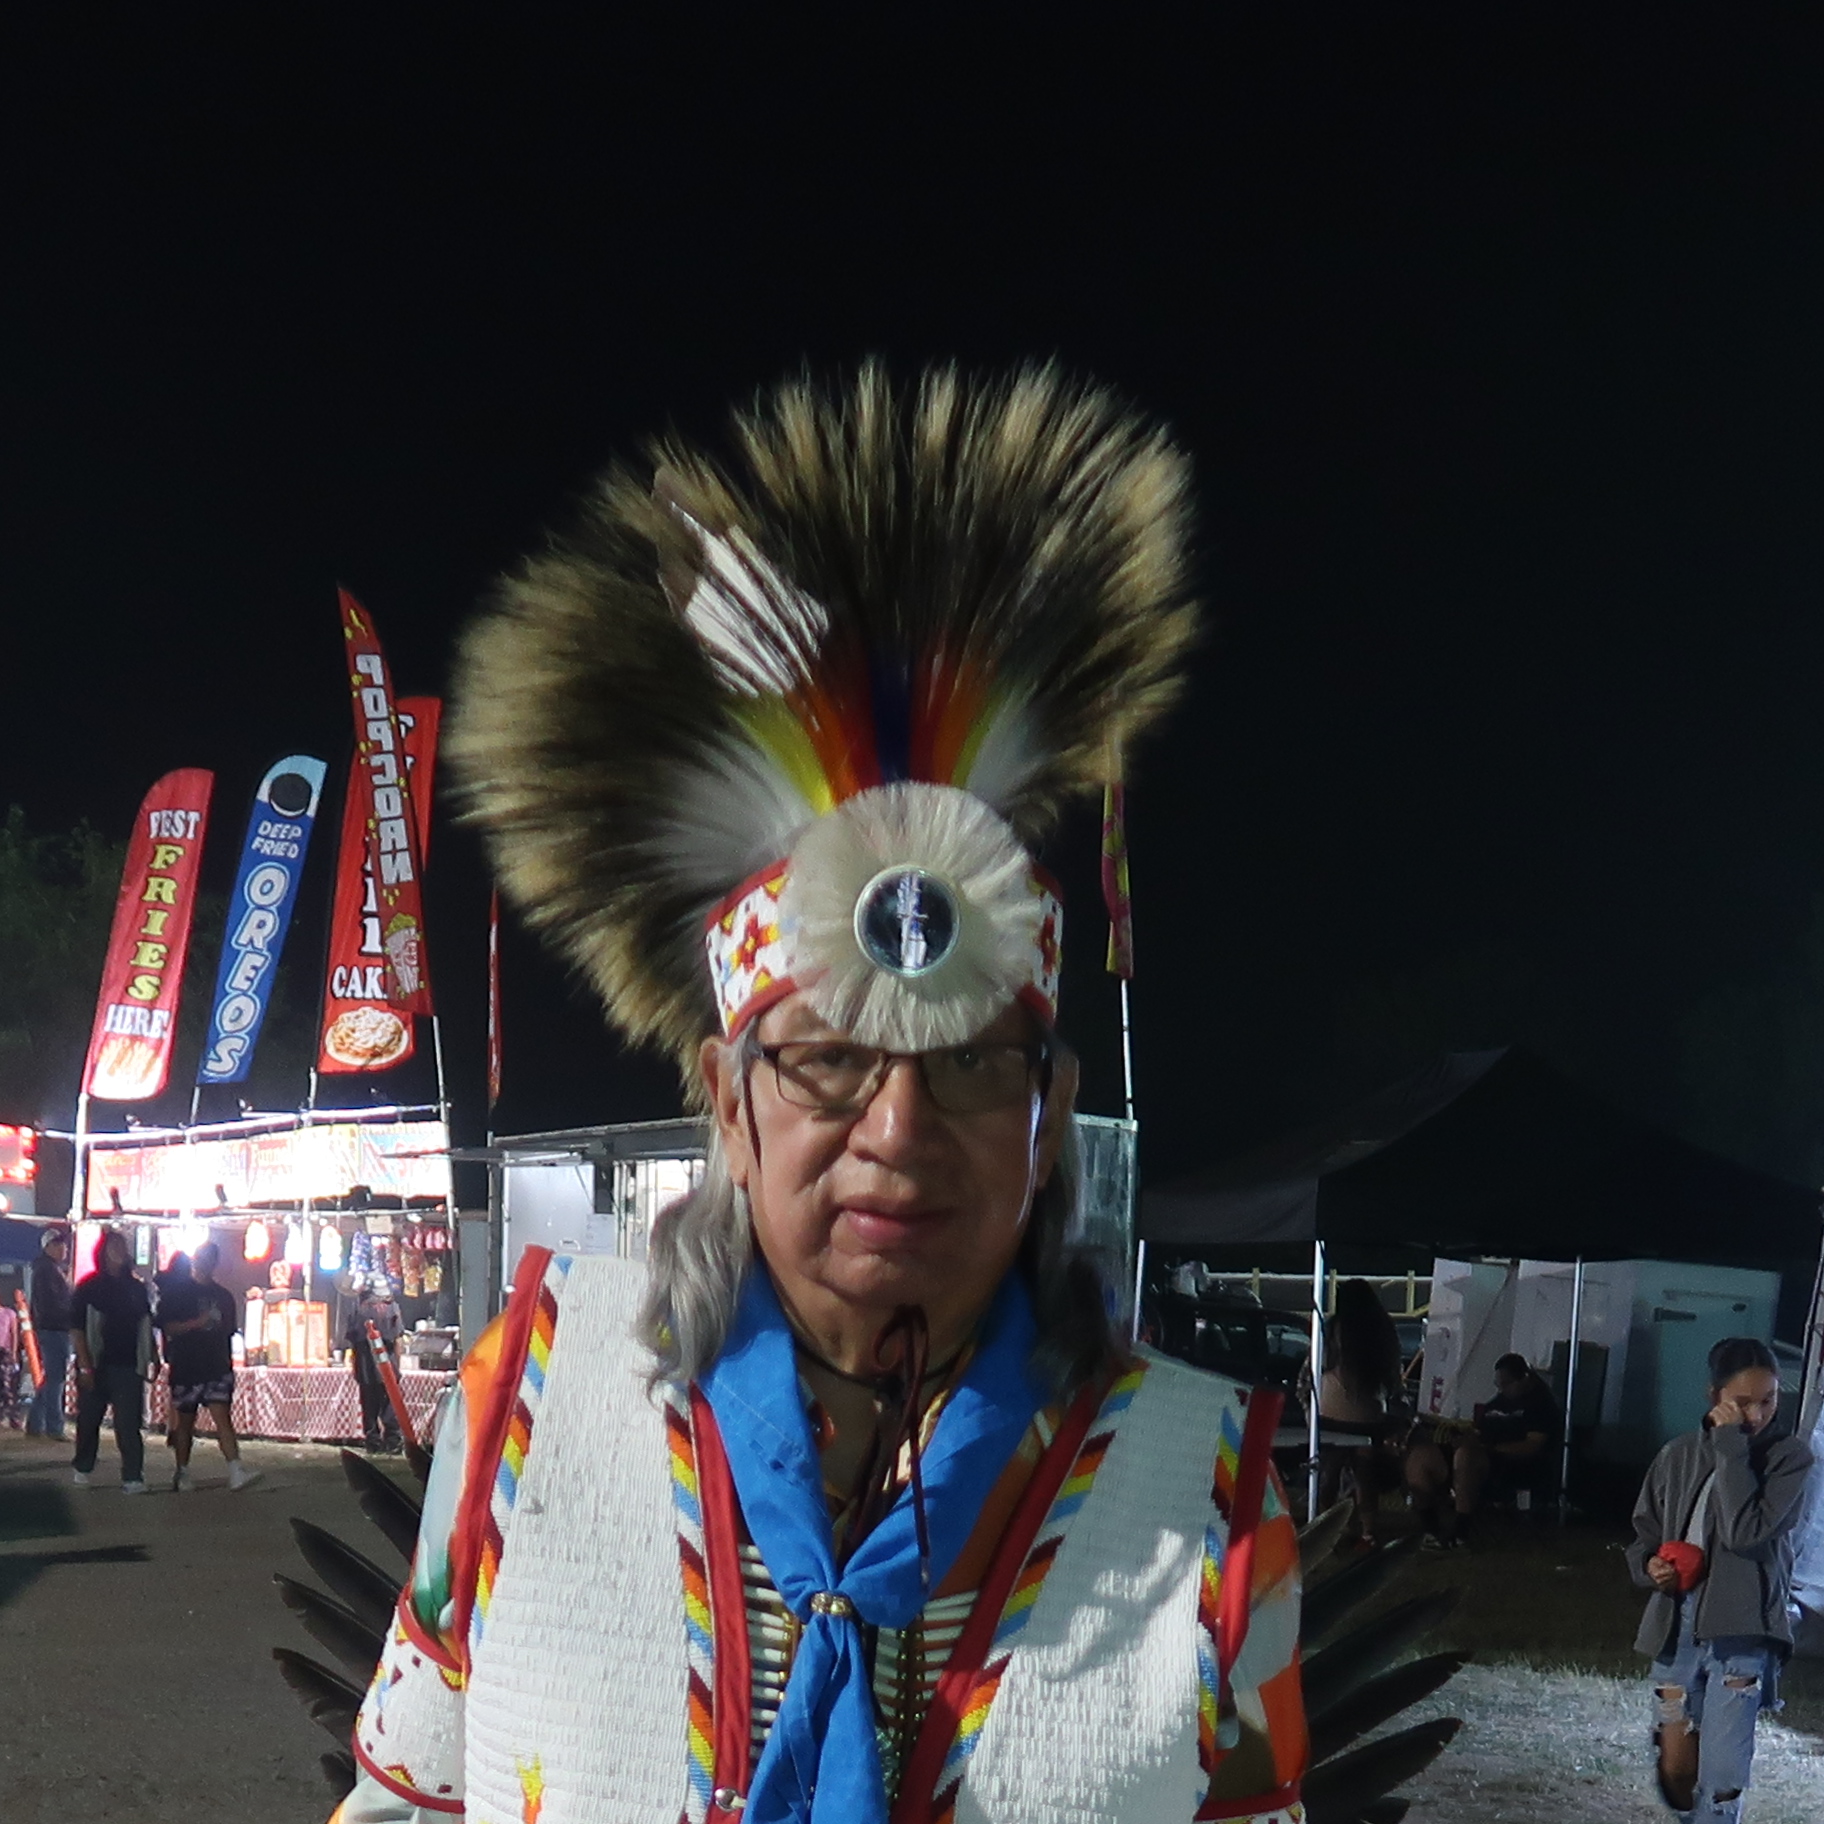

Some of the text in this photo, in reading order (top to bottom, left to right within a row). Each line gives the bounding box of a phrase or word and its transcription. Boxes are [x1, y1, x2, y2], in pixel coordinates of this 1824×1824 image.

[258, 820, 302, 840] DEEP
[251, 837, 299, 860] FRIED
[125, 844, 186, 1002] FRIES
[202, 861, 291, 1075] OREOS
[332, 965, 388, 999] CAK
[103, 1003, 170, 1040] HERE!
